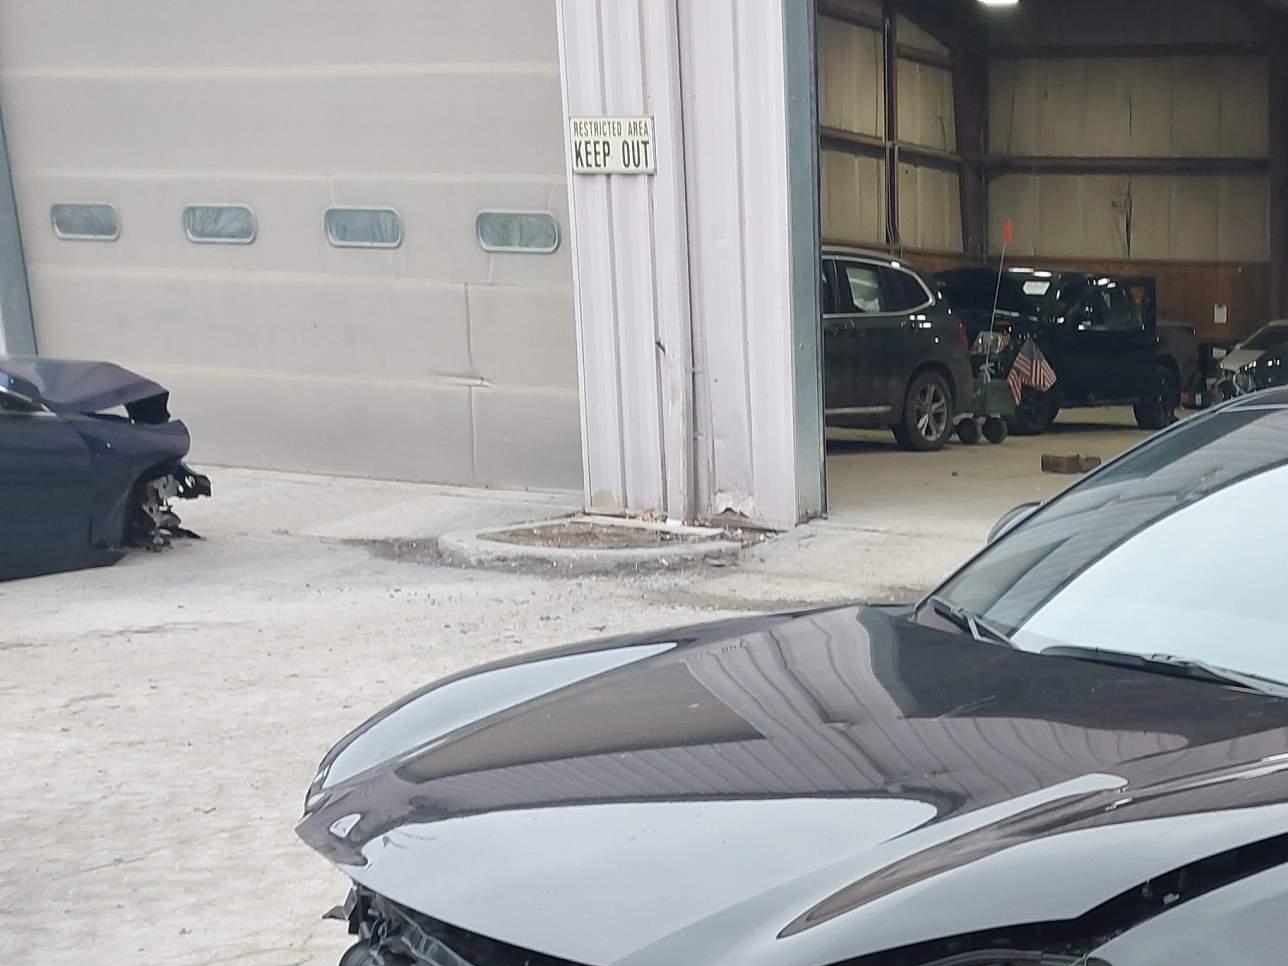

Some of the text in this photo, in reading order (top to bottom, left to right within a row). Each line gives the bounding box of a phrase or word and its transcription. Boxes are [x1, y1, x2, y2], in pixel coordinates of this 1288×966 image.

[574, 121, 649, 136] RESTRICTED AREA
[574, 140, 649, 168] KEEP OUT
